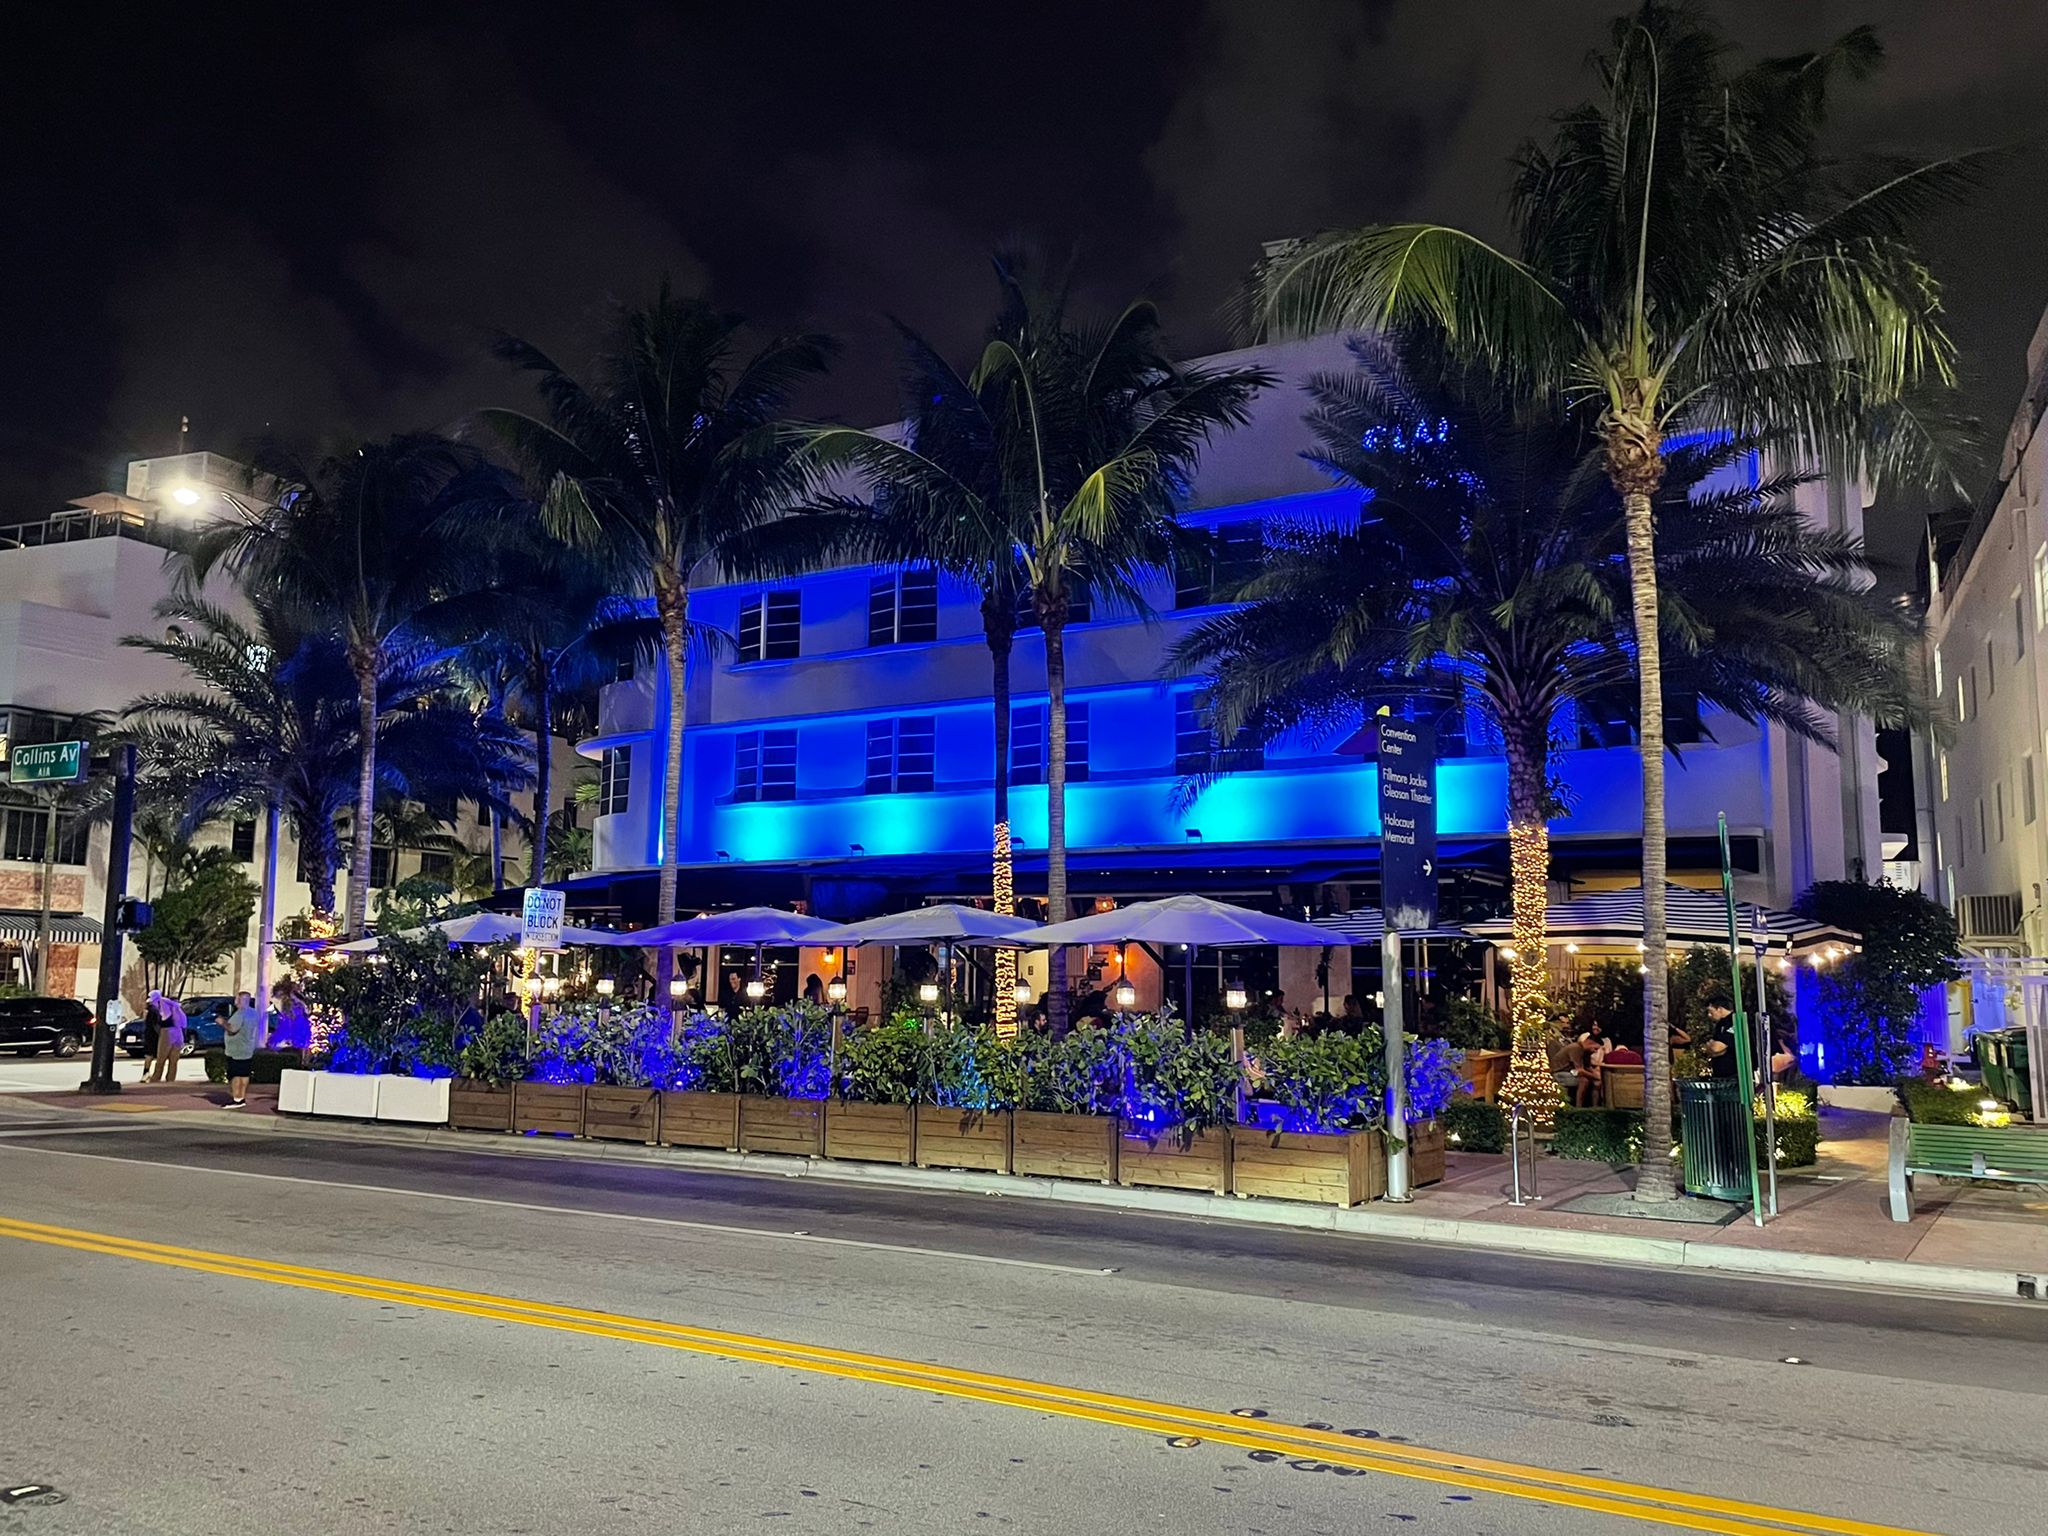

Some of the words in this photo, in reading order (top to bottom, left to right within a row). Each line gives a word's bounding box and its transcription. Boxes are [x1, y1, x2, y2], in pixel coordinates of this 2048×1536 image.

[1381, 724, 1416, 742] Convention
[15, 747, 56, 765] Collins
[60, 746, 77, 762] Av
[1381, 740, 1402, 755] Center
[1383, 767, 1408, 784] Fillmore
[1409, 773, 1427, 788] Jackie
[1383, 784, 1410, 801] Gleason
[1410, 789, 1432, 804] Theater
[1384, 813, 1415, 828] Holocaust
[1385, 830, 1415, 845] Memorial
[527, 895, 541, 909] DO
[543, 897, 562, 911] NOT
[527, 914, 558, 929] BLOCK
